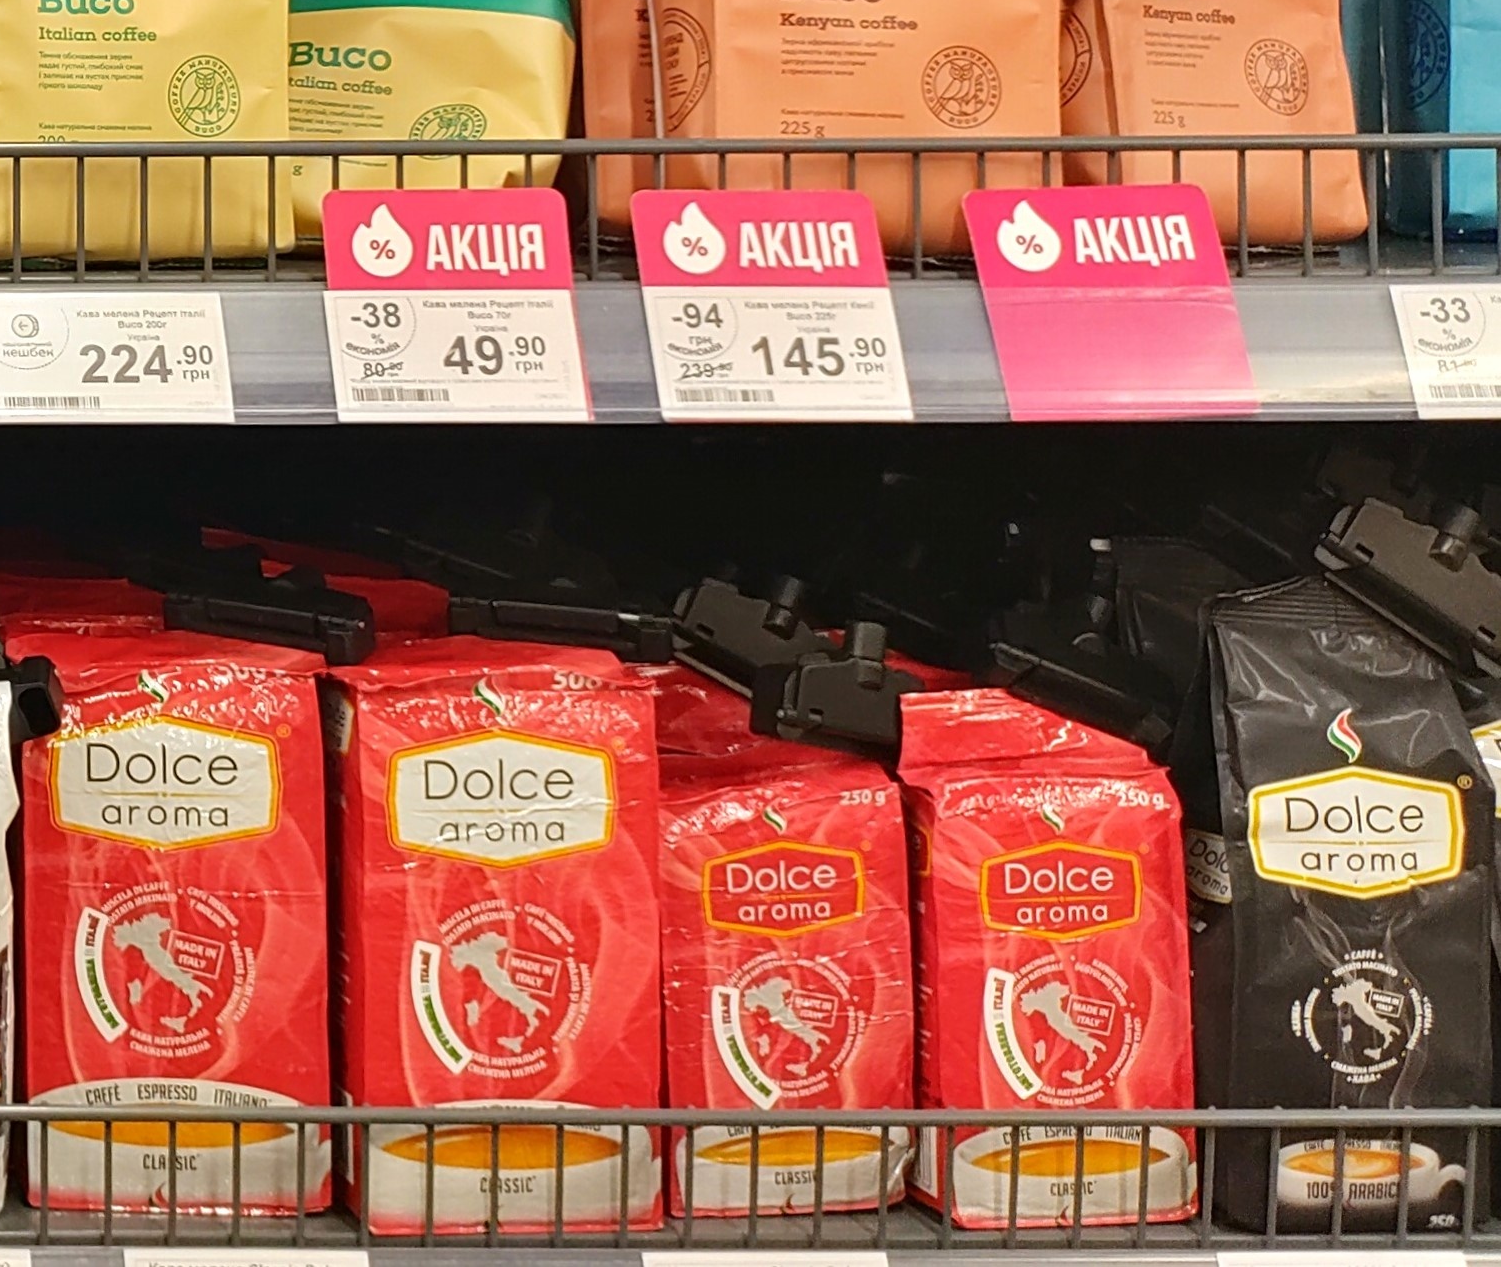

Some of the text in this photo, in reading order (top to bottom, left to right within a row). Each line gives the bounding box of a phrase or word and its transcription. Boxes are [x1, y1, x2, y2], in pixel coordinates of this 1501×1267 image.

[38, 27, 157, 42] Italian coffee
[780, 13, 918, 31] Kenyan coffee
[426, 224, 545, 276] АКЦІЯ
[739, 221, 860, 275] АКЦІЯ
[1073, 214, 1196, 268] АКЦІЯ
[672, 303, 723, 330] -94
[1420, 298, 1470, 323] -33
[79, 344, 173, 384] 224
[443, 336, 504, 376] 49
[751, 337, 845, 377] 145
[86, 742, 239, 786] Dolce
[101, 802, 229, 828] aroma
[1285, 797, 1425, 834] Dolce
[726, 859, 836, 893] Dolce
[1301, 848, 1419, 874] aroma
[1004, 863, 1114, 894] Dolce
[738, 899, 831, 921] aroma
[1017, 902, 1109, 924] aroma
